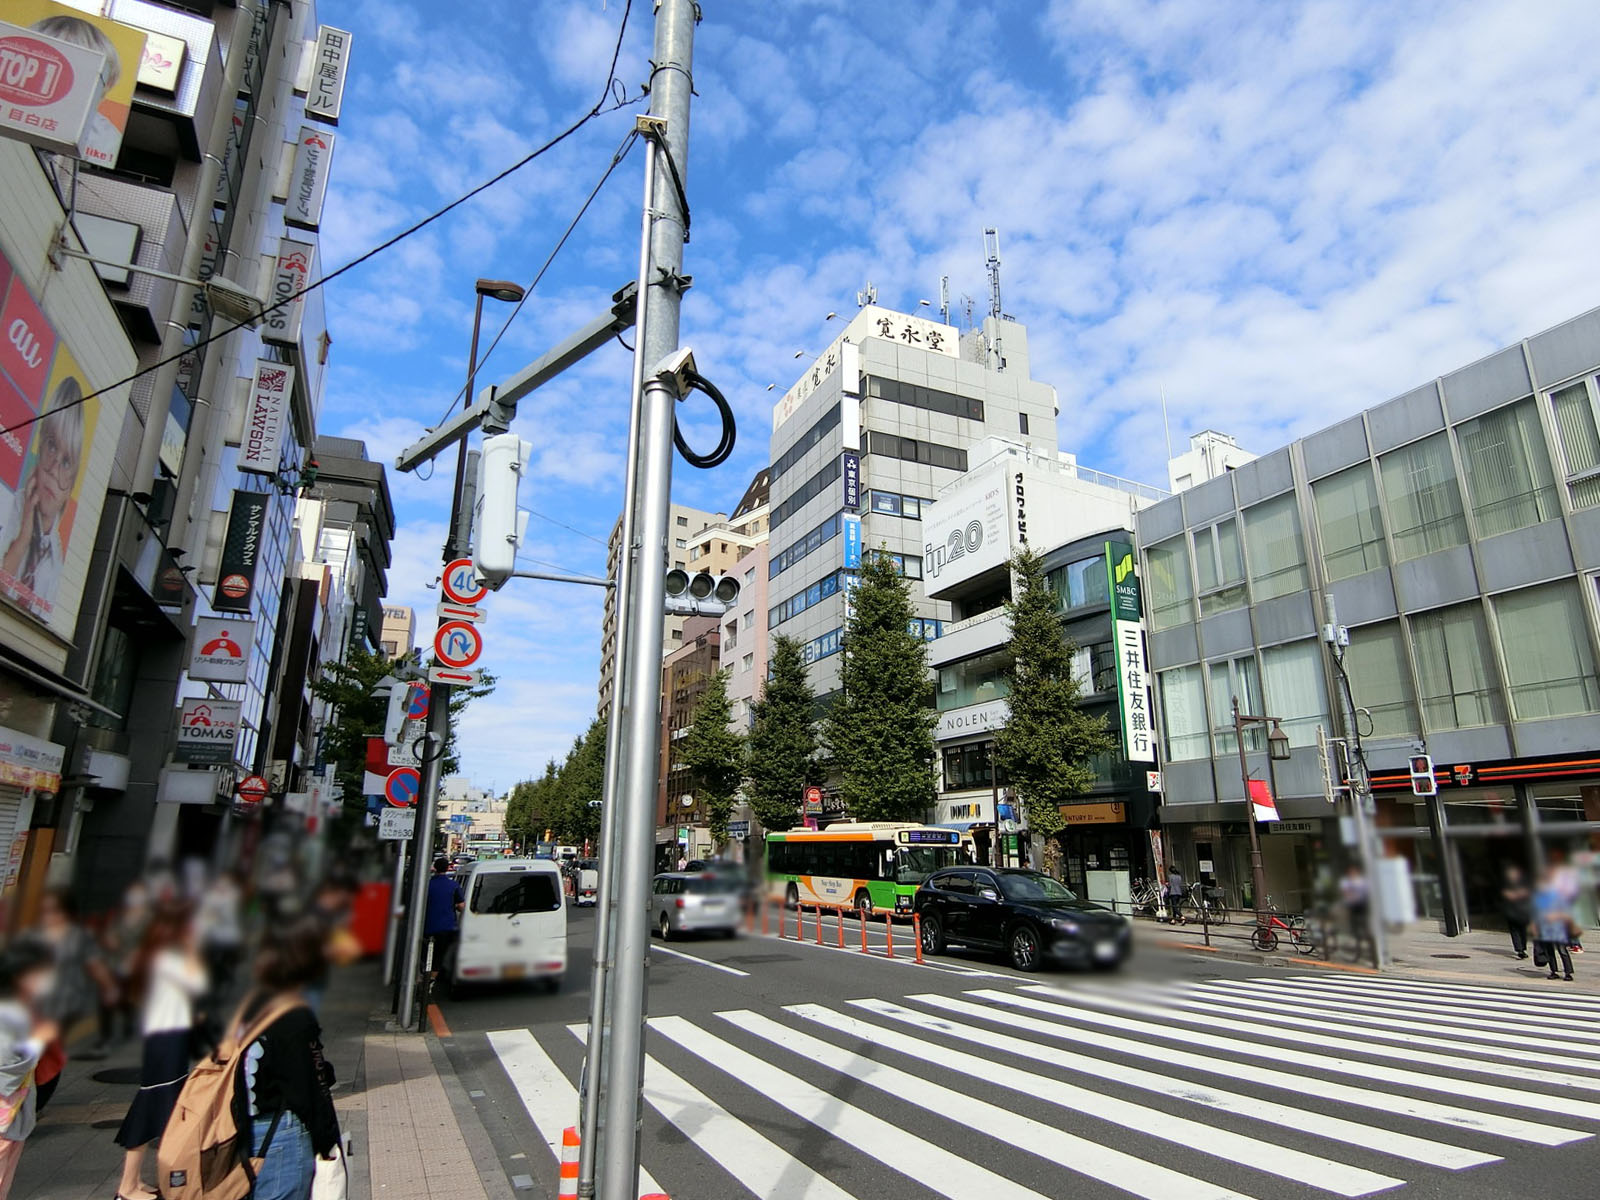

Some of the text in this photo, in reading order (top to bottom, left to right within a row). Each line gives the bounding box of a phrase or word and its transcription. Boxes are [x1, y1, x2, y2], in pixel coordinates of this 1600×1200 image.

[0, 49, 39, 88] TOP
[40, 65, 57, 96] 1
[313, 33, 344, 109] 田中屋ビル
[8, 108, 59, 132] 目白店
[269, 273, 296, 330] TOMAS
[8, 318, 42, 368] au
[876, 317, 945, 352] 寛永堂
[246, 394, 270, 462] LAWSON
[260, 396, 281, 463] NATURAL
[847, 470, 857, 505] 東京個別
[242, 504, 263, 566] サンマルクカフェ
[925, 519, 984, 579] ip20
[453, 571, 479, 593] 40
[1116, 584, 1137, 595] SMBC
[1124, 629, 1148, 752] 三井住友銀行
[181, 726, 234, 739] TOMAS
[947, 712, 988, 730] NOLEN
[382, 828, 413, 838] ここから30
[1272, 823, 1312, 832] 三井住友銀行
